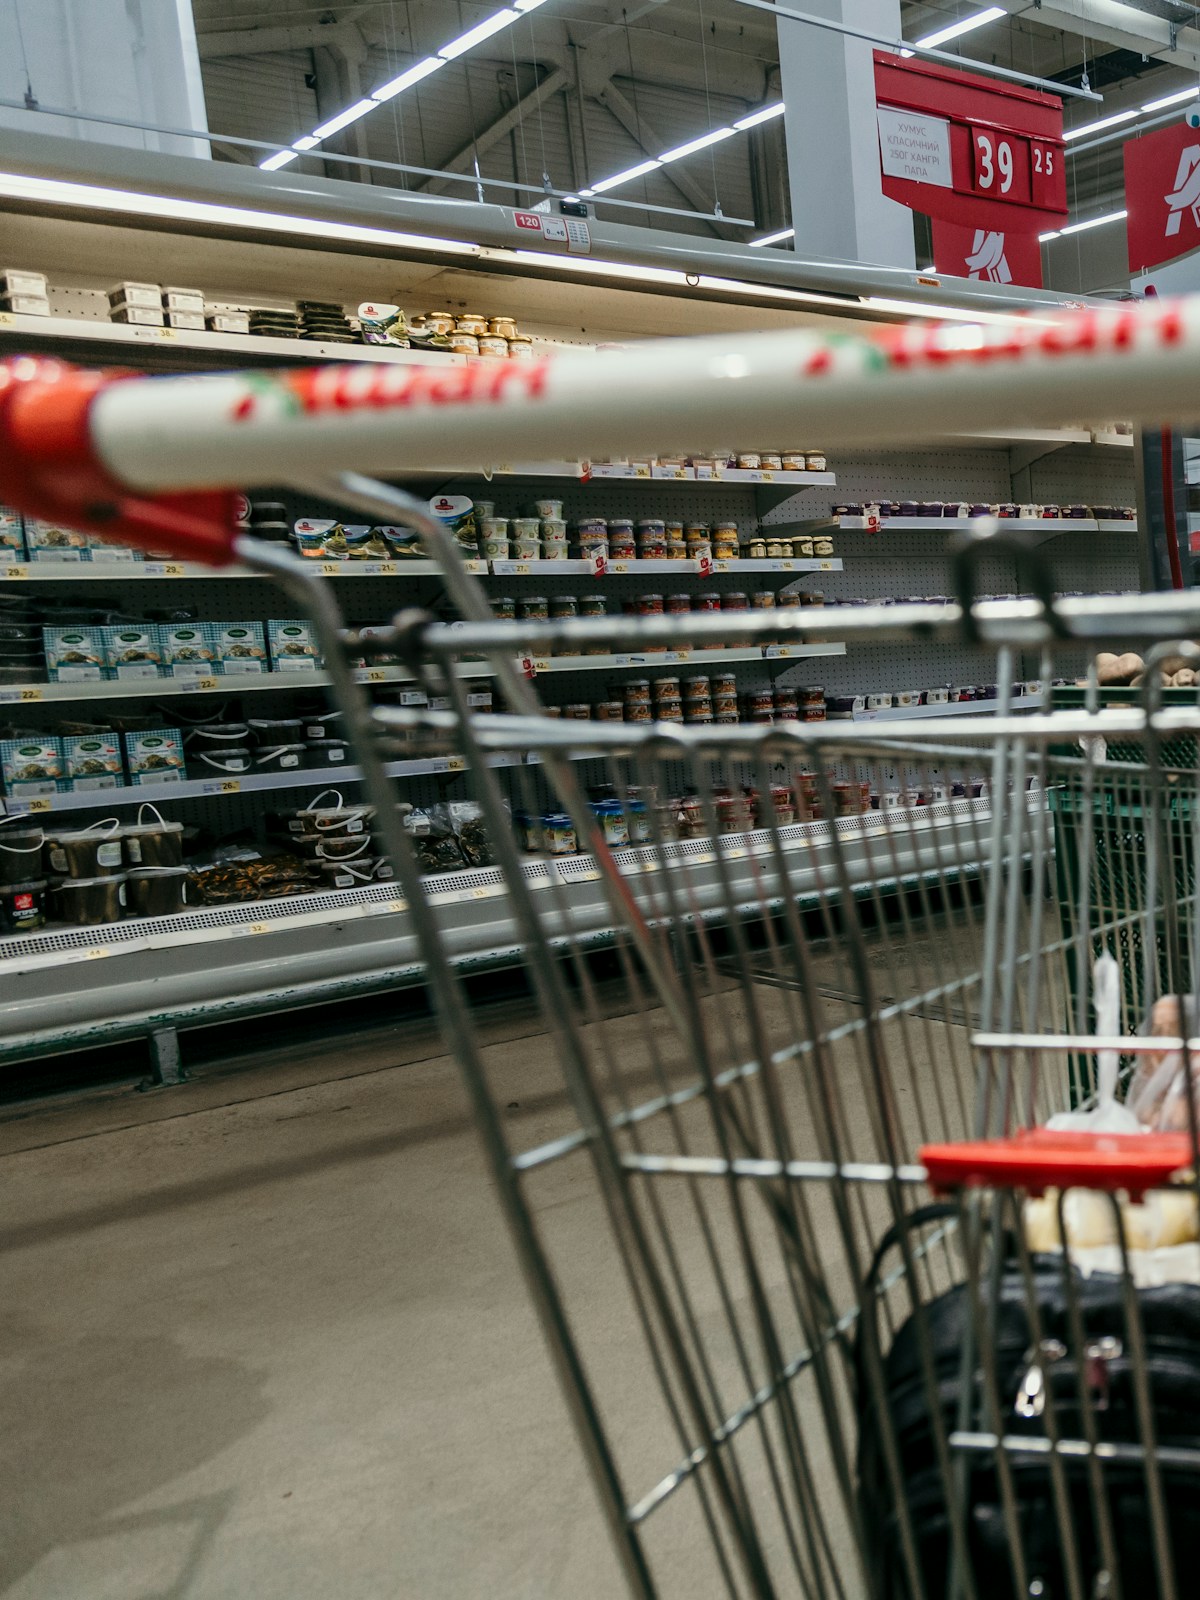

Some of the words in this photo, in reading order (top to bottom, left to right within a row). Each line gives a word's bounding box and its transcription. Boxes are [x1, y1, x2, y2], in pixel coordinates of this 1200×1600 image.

[897, 123, 927, 137] ХУМУС
[886, 134, 940, 152] КЛАСИЧНИЙ
[910, 150, 940, 165] ХАНГРІ
[977, 135, 1014, 194] 39
[1034, 148, 1054, 176] 25
[904, 164, 929, 177] ПАПА
[519, 215, 539, 227] 120
[8, 568, 20, 577] 29
[165, 565, 177, 574] 29
[323, 564, 333, 572] 13
[201, 680, 211, 688] 22
[23, 691, 34, 699] 22
[222, 782, 232, 790] 26
